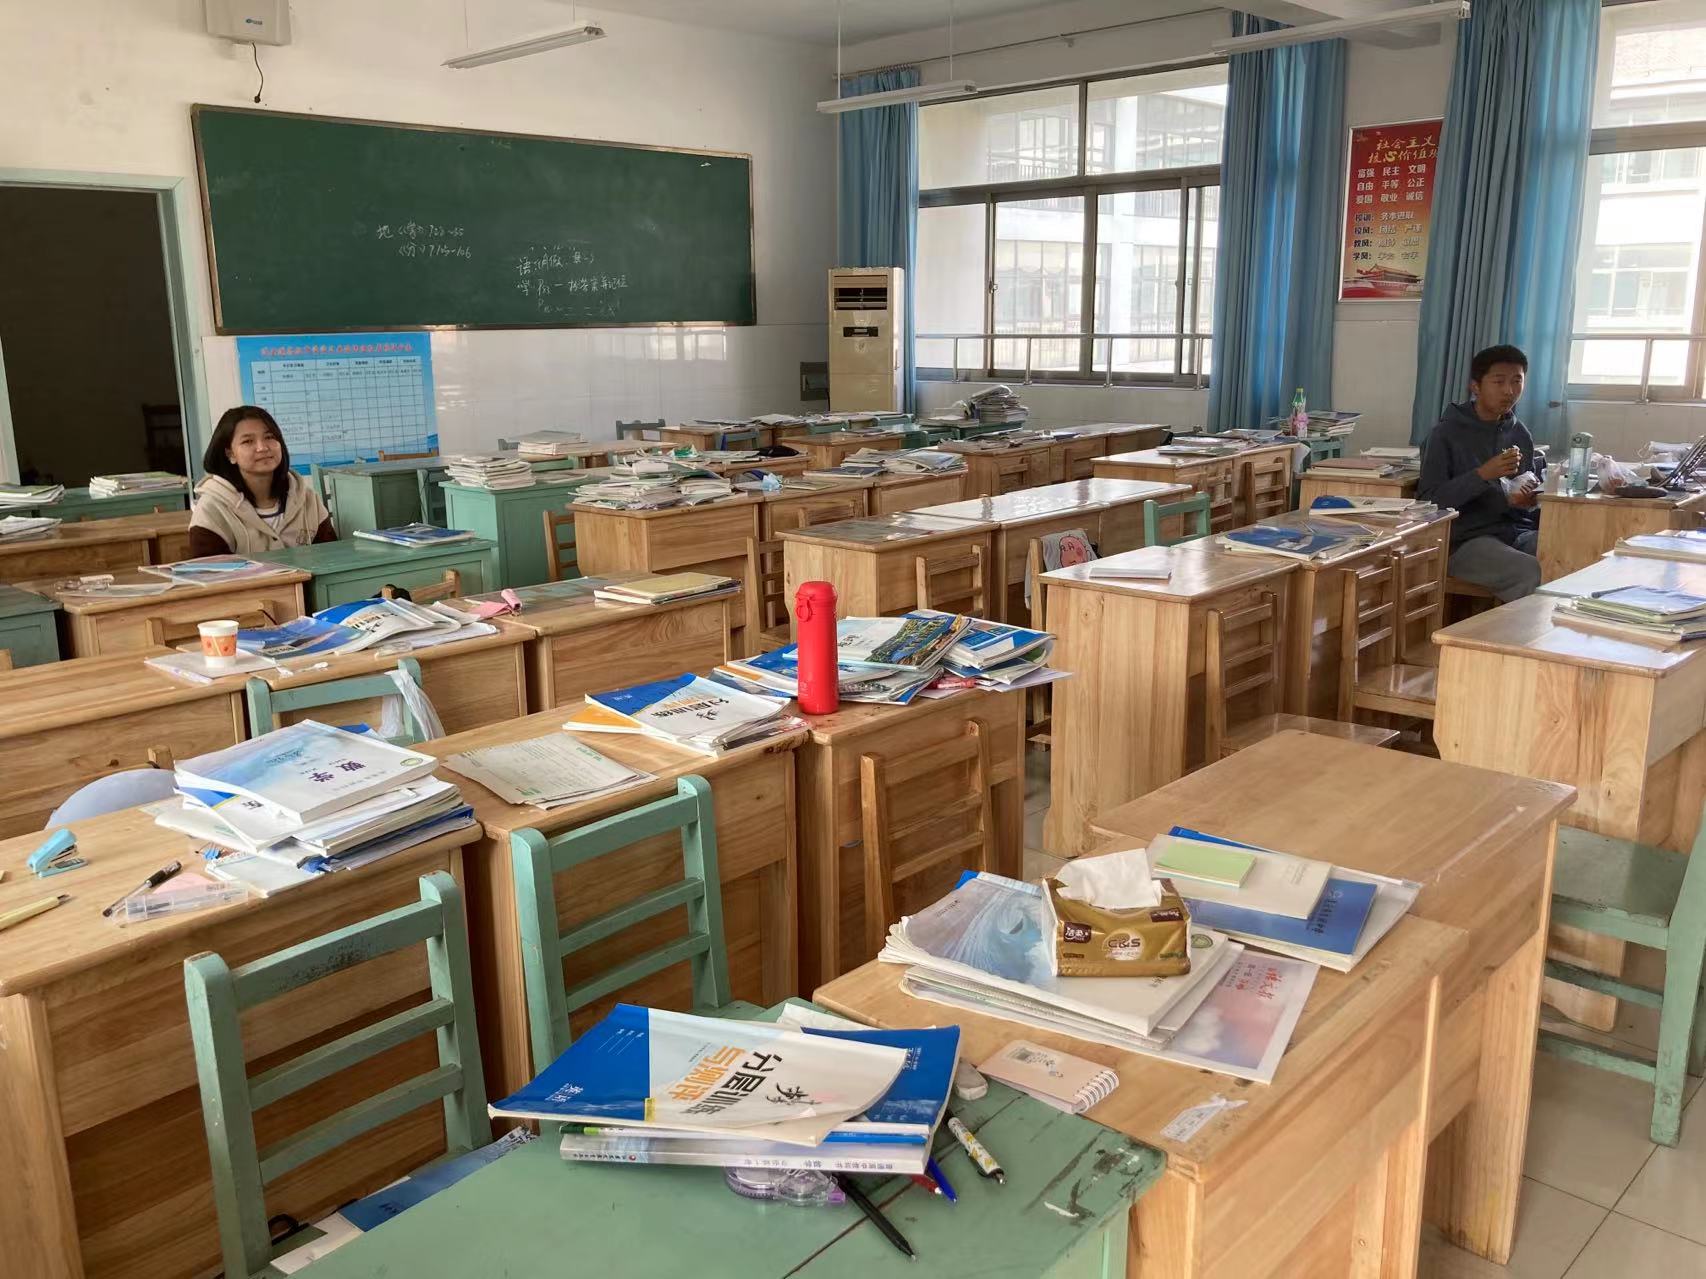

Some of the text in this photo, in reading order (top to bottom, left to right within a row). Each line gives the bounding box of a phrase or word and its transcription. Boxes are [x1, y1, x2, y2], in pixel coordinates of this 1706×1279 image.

[1377, 136, 1436, 150] 社会主义
[1357, 163, 1426, 179] 富强 民主 文明
[1356, 178, 1425, 192] 自由 平等 公正
[1355, 191, 1424, 205] 爱国 敬业 诚信
[307, 761, 368, 783] 数学
[1108, 938, 1141, 949] C&S
[679, 1050, 785, 1117] 分层训练
